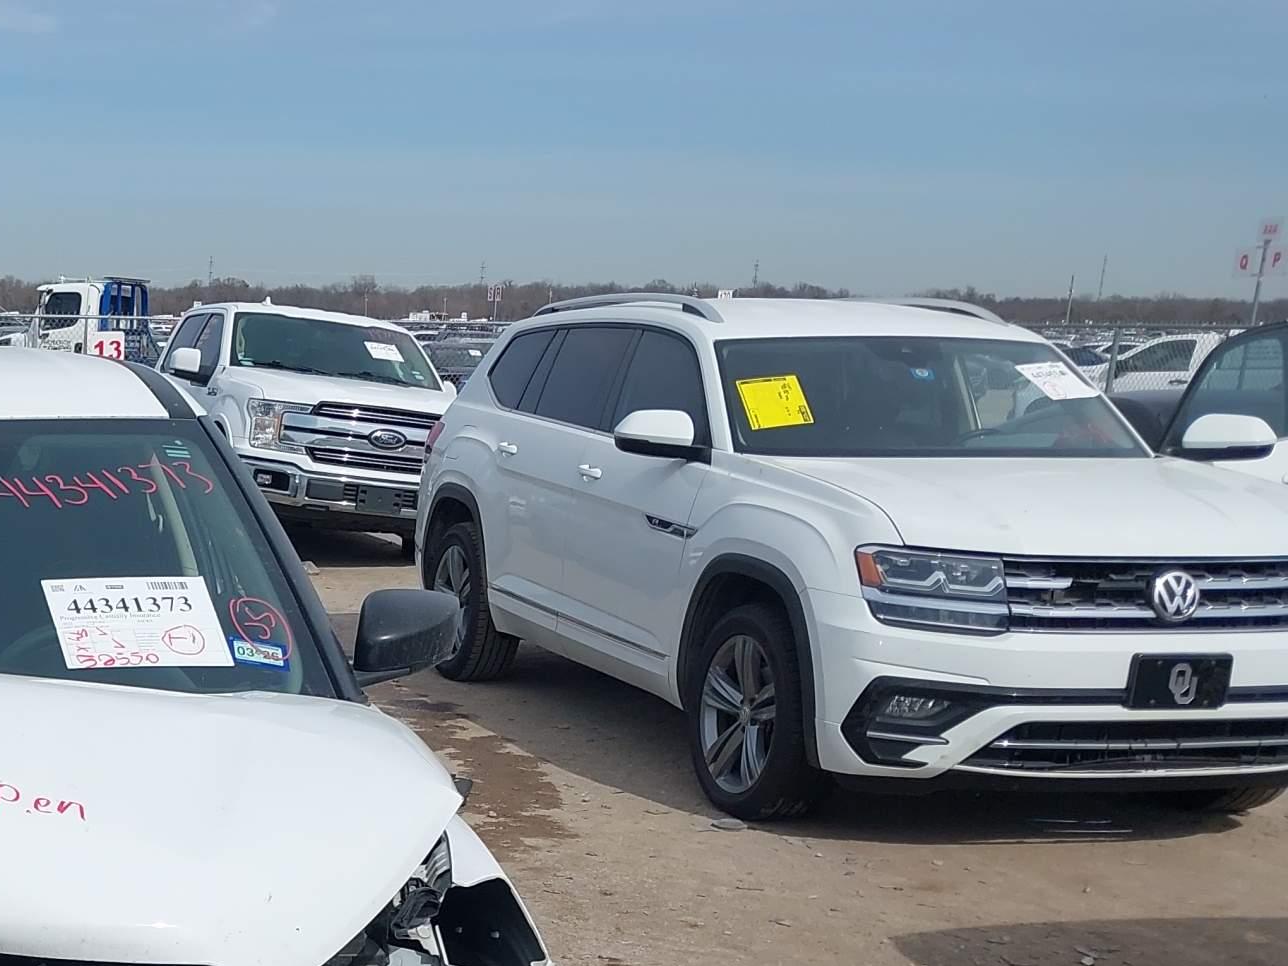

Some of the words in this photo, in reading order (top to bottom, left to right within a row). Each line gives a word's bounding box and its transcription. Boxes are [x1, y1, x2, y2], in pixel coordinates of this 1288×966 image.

[1239, 254, 1249, 270] Q
[1272, 251, 1282, 268] P
[94, 339, 122, 360] 13
[66, 595, 193, 614] 44341373
